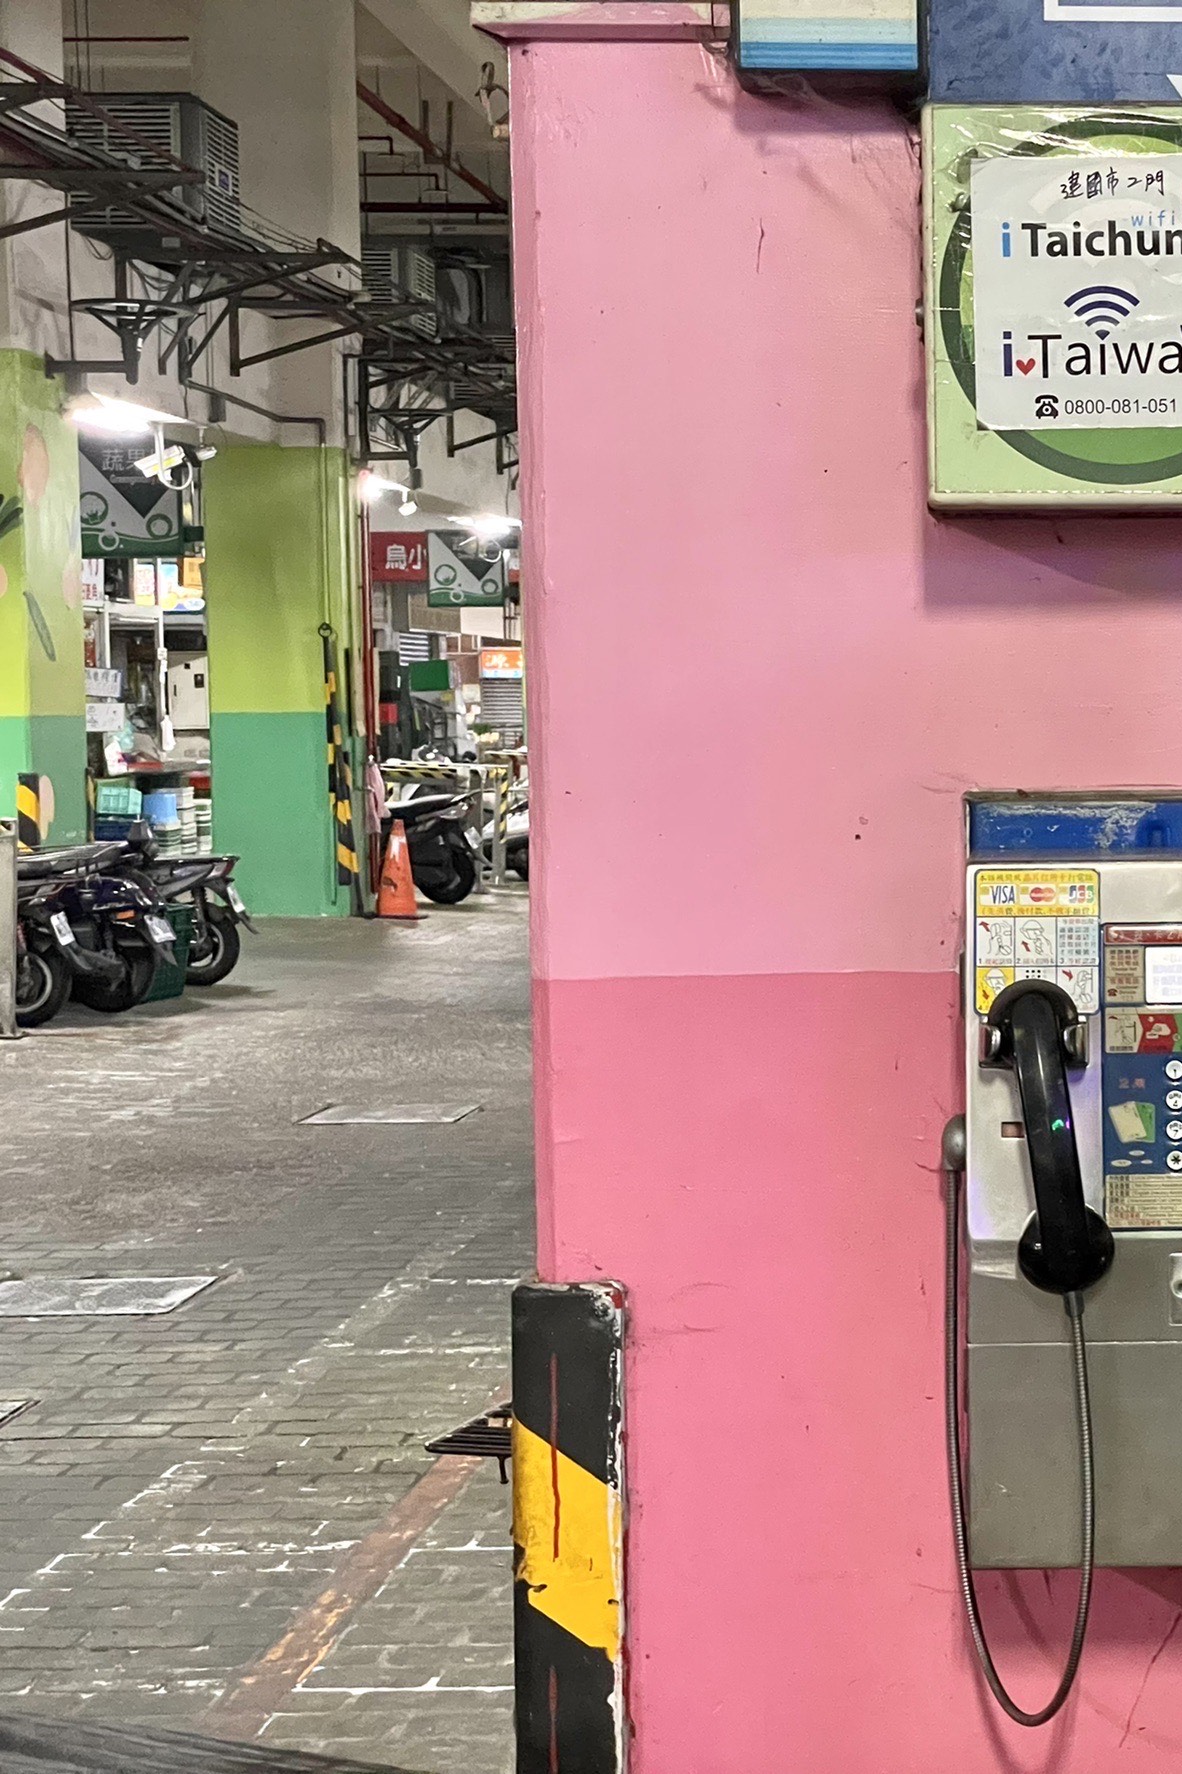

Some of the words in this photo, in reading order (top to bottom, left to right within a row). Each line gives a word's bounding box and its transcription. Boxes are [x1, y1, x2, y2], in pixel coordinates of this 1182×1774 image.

[1131, 210, 1175, 227] wifi
[1064, 397, 1178, 416] 0800-081-051
[990, 885, 1016, 905] VISA
